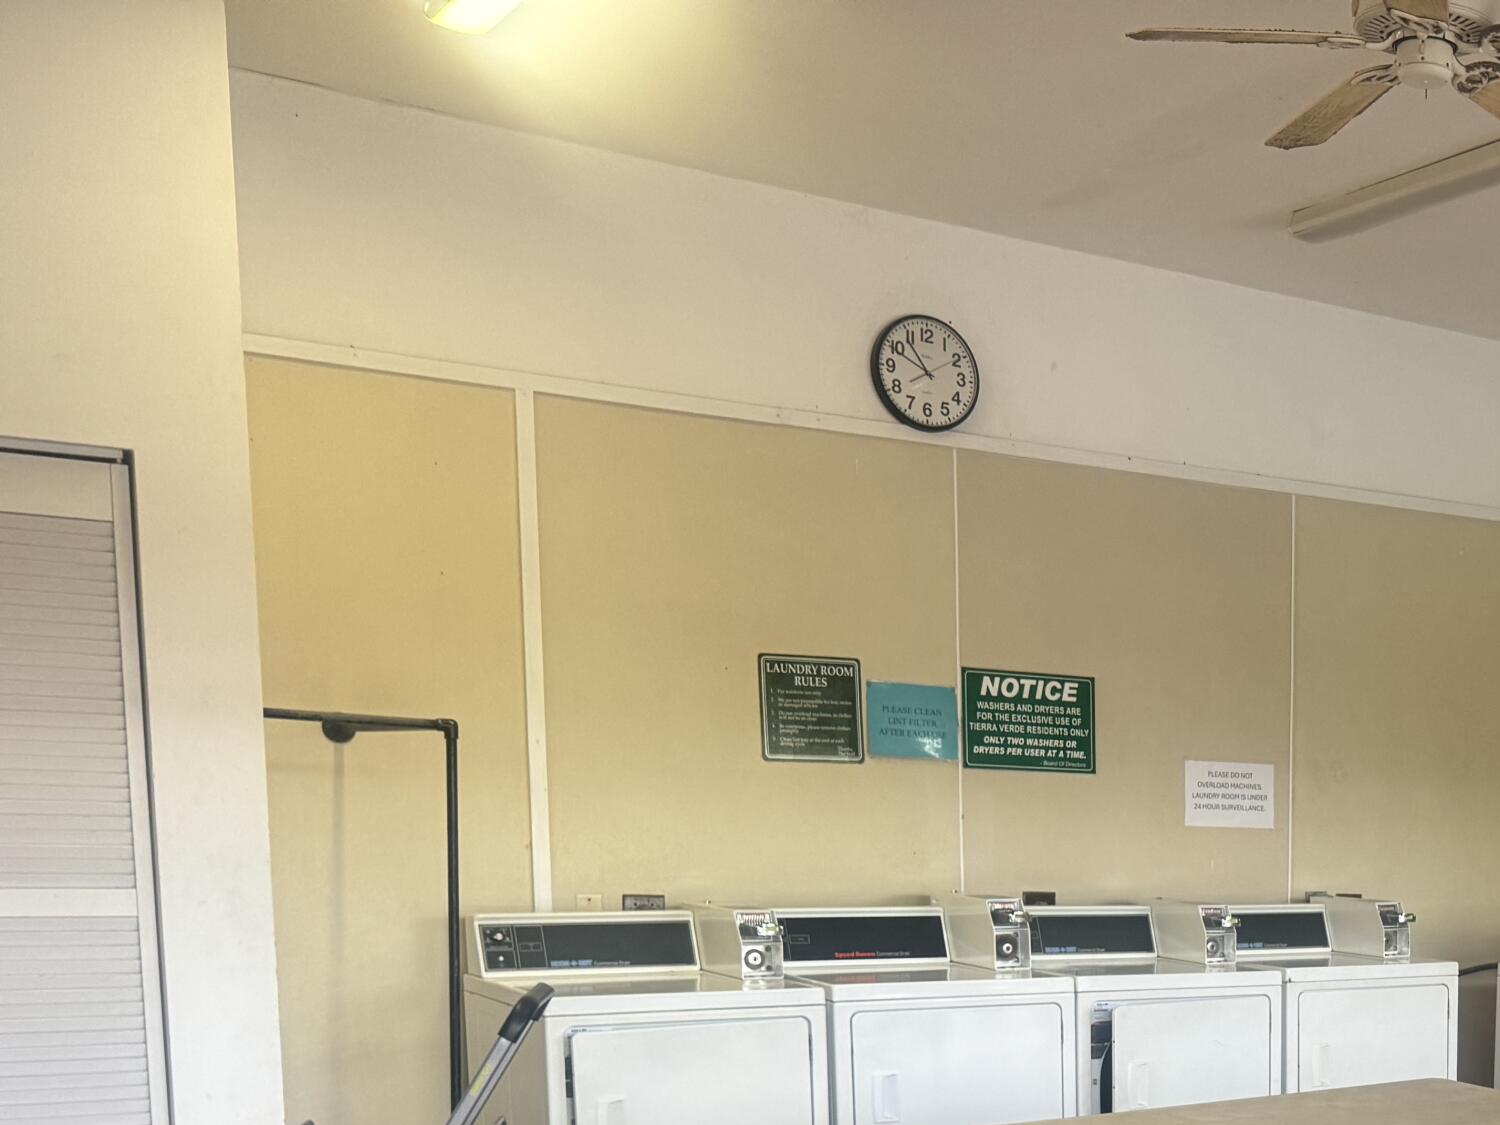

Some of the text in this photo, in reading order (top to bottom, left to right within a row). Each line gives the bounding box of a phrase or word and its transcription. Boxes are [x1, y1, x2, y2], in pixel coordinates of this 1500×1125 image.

[906, 329, 915, 345] 11
[920, 328, 934, 344] 12
[891, 339, 905, 354] 10
[942, 337, 947, 352] 1
[885, 358, 896, 373] 9
[951, 352, 962, 368] 2
[891, 378, 902, 394] 8
[956, 372, 966, 387] 3
[906, 394, 916, 410] 7
[951, 391, 961, 406] 4
[922, 402, 933, 417] 6
[940, 402, 950, 416] 5
[766, 662, 854, 677] LAUNDRY ROOM
[794, 676, 829, 688] RULES
[980, 676, 1079, 702] NOTICE
[882, 704, 943, 717] PLEASE CLEAN
[976, 701, 1082, 716] WASHERS AND DRYERS ARE
[976, 712, 1082, 726] FOR THE EXCLUSIVE USE OF
[879, 728, 905, 737] AFTER
[969, 722, 1090, 737] TIERRA VERDE RESIDENTS ONLY
[983, 736, 1077, 749] ONLY TWO WASHERS OR
[973, 746, 1005, 755] DRYERS
[1006, 747, 1023, 756] PER
[1024, 749, 1045, 757] USER
[1066, 751, 1087, 760] TIME.
[1207, 770, 1229, 778] PLEASE
[1230, 771, 1239, 779] DO
[1197, 781, 1230, 789] OVERLOAD
[1191, 792, 1220, 800] LAUNDRY
[1221, 793, 1240, 801] ROOM
